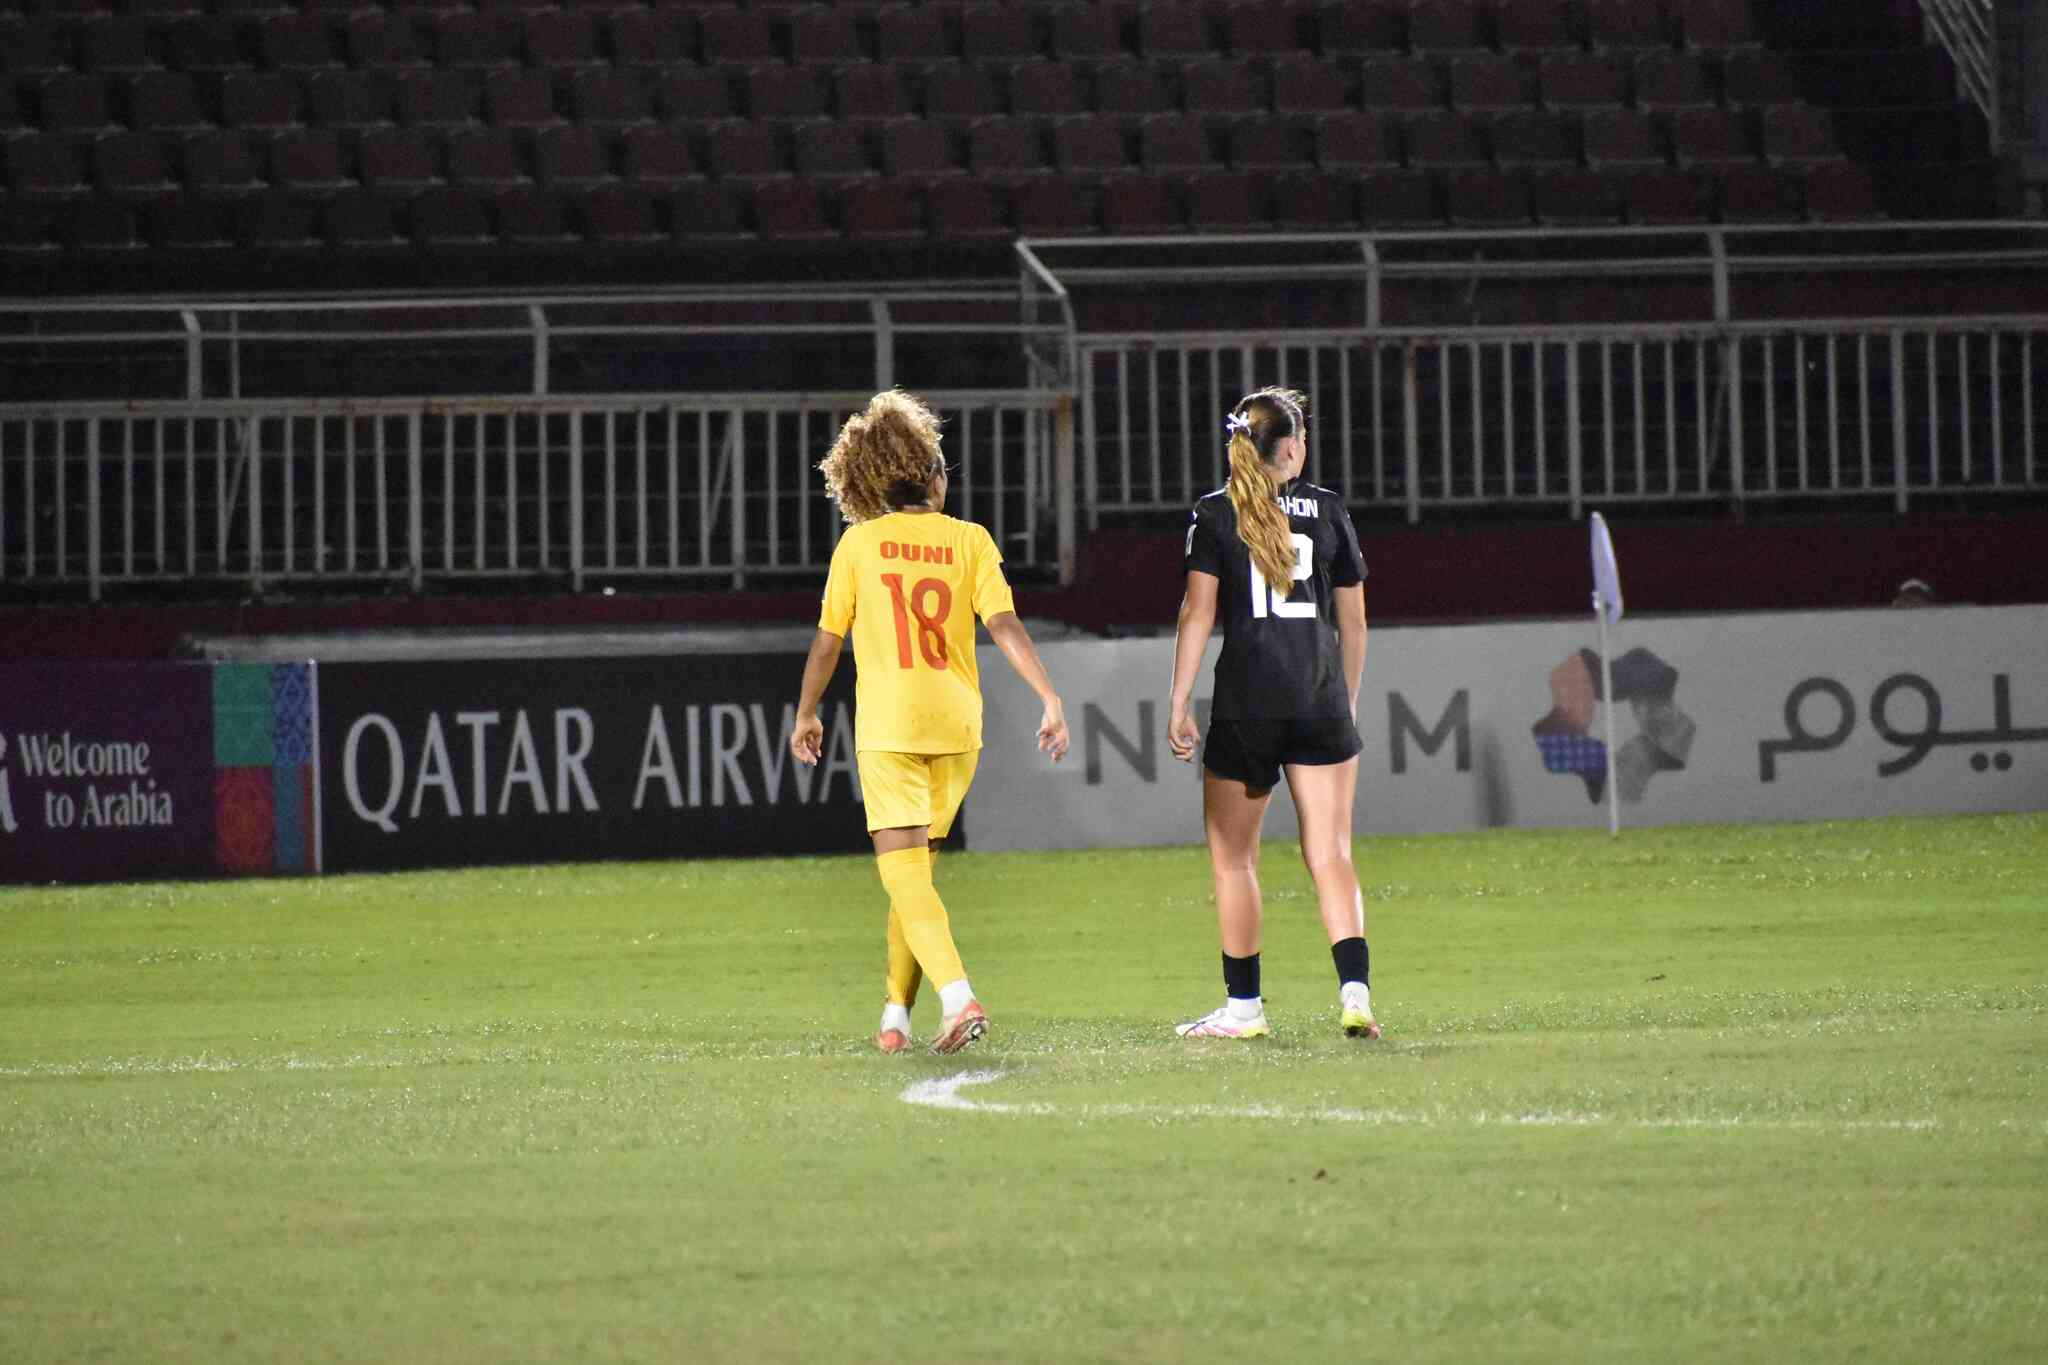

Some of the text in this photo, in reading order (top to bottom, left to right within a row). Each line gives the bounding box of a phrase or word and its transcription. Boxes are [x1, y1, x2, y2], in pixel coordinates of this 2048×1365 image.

[1275, 496, 1319, 519] AHON
[880, 541, 954, 566] OUNI
[1249, 533, 1317, 618] 12
[879, 573, 953, 671] 18
[18, 732, 150, 777] Welcome
[343, 700, 865, 833] QATAR AIRWA
[1083, 689, 1472, 787] NM
[1759, 672, 2048, 783] يوم
[44, 778, 173, 828] to Arabia
